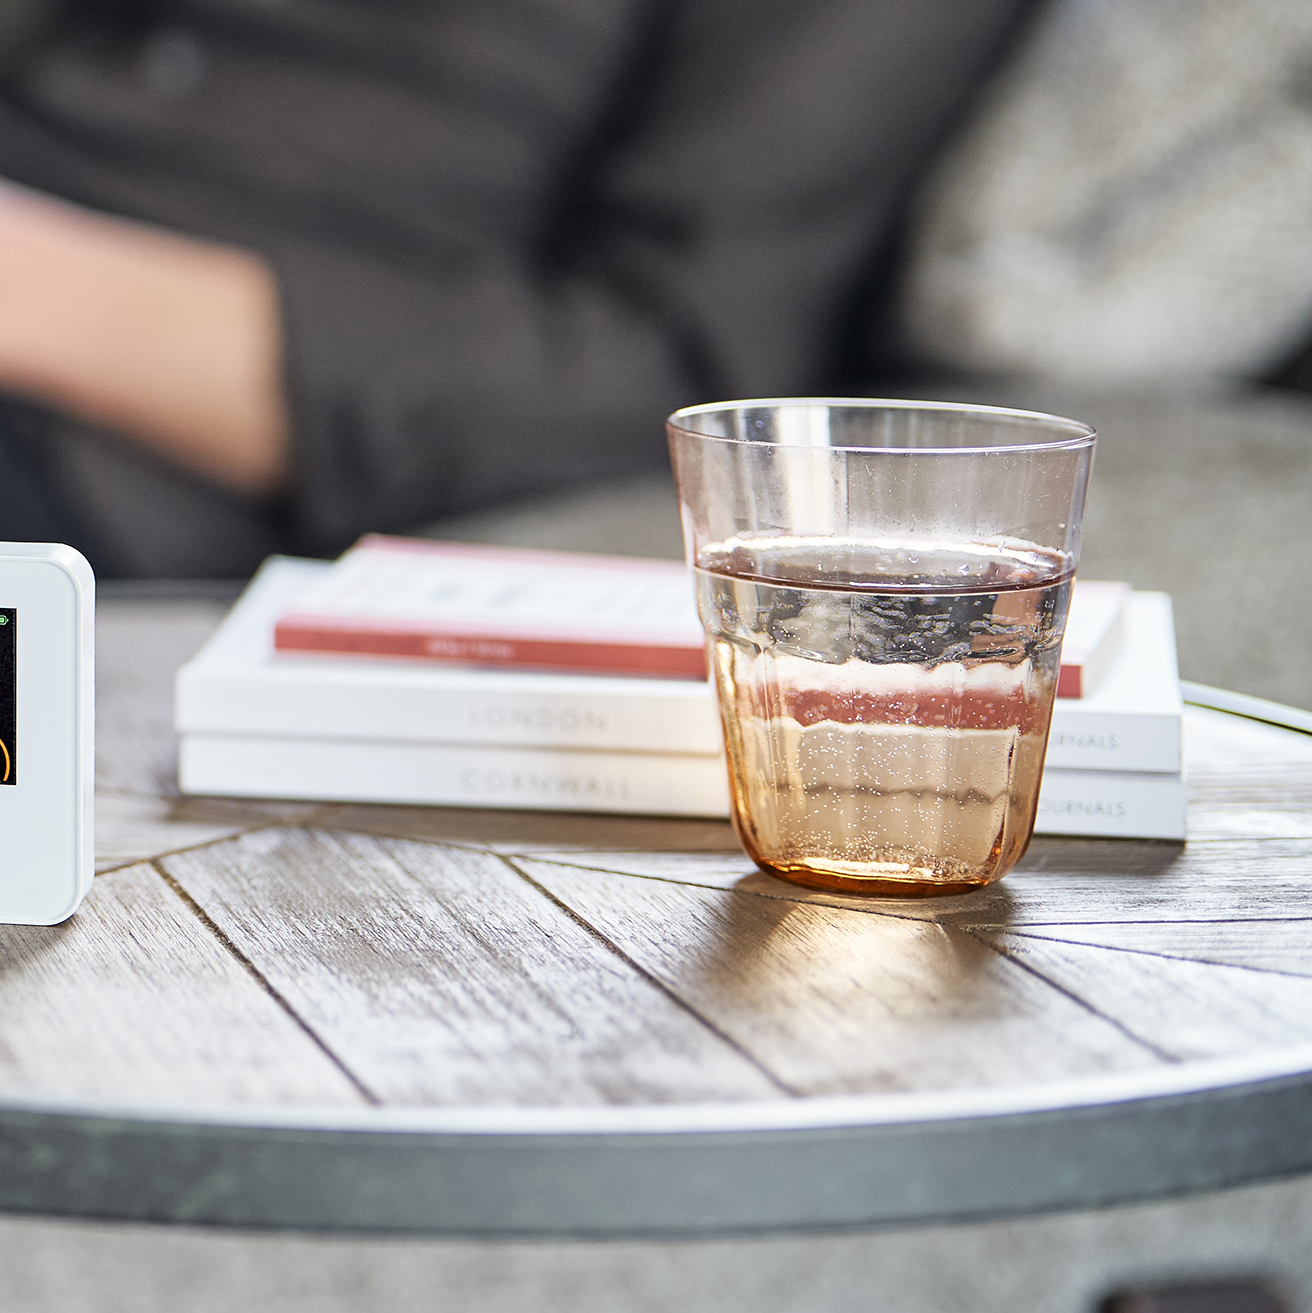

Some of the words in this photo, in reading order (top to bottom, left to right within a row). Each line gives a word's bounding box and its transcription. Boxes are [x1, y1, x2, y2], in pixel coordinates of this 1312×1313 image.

[469, 703, 608, 732] LONDON
[459, 767, 631, 801] CORNWALL
[1038, 798, 1127, 818] OURNALS
